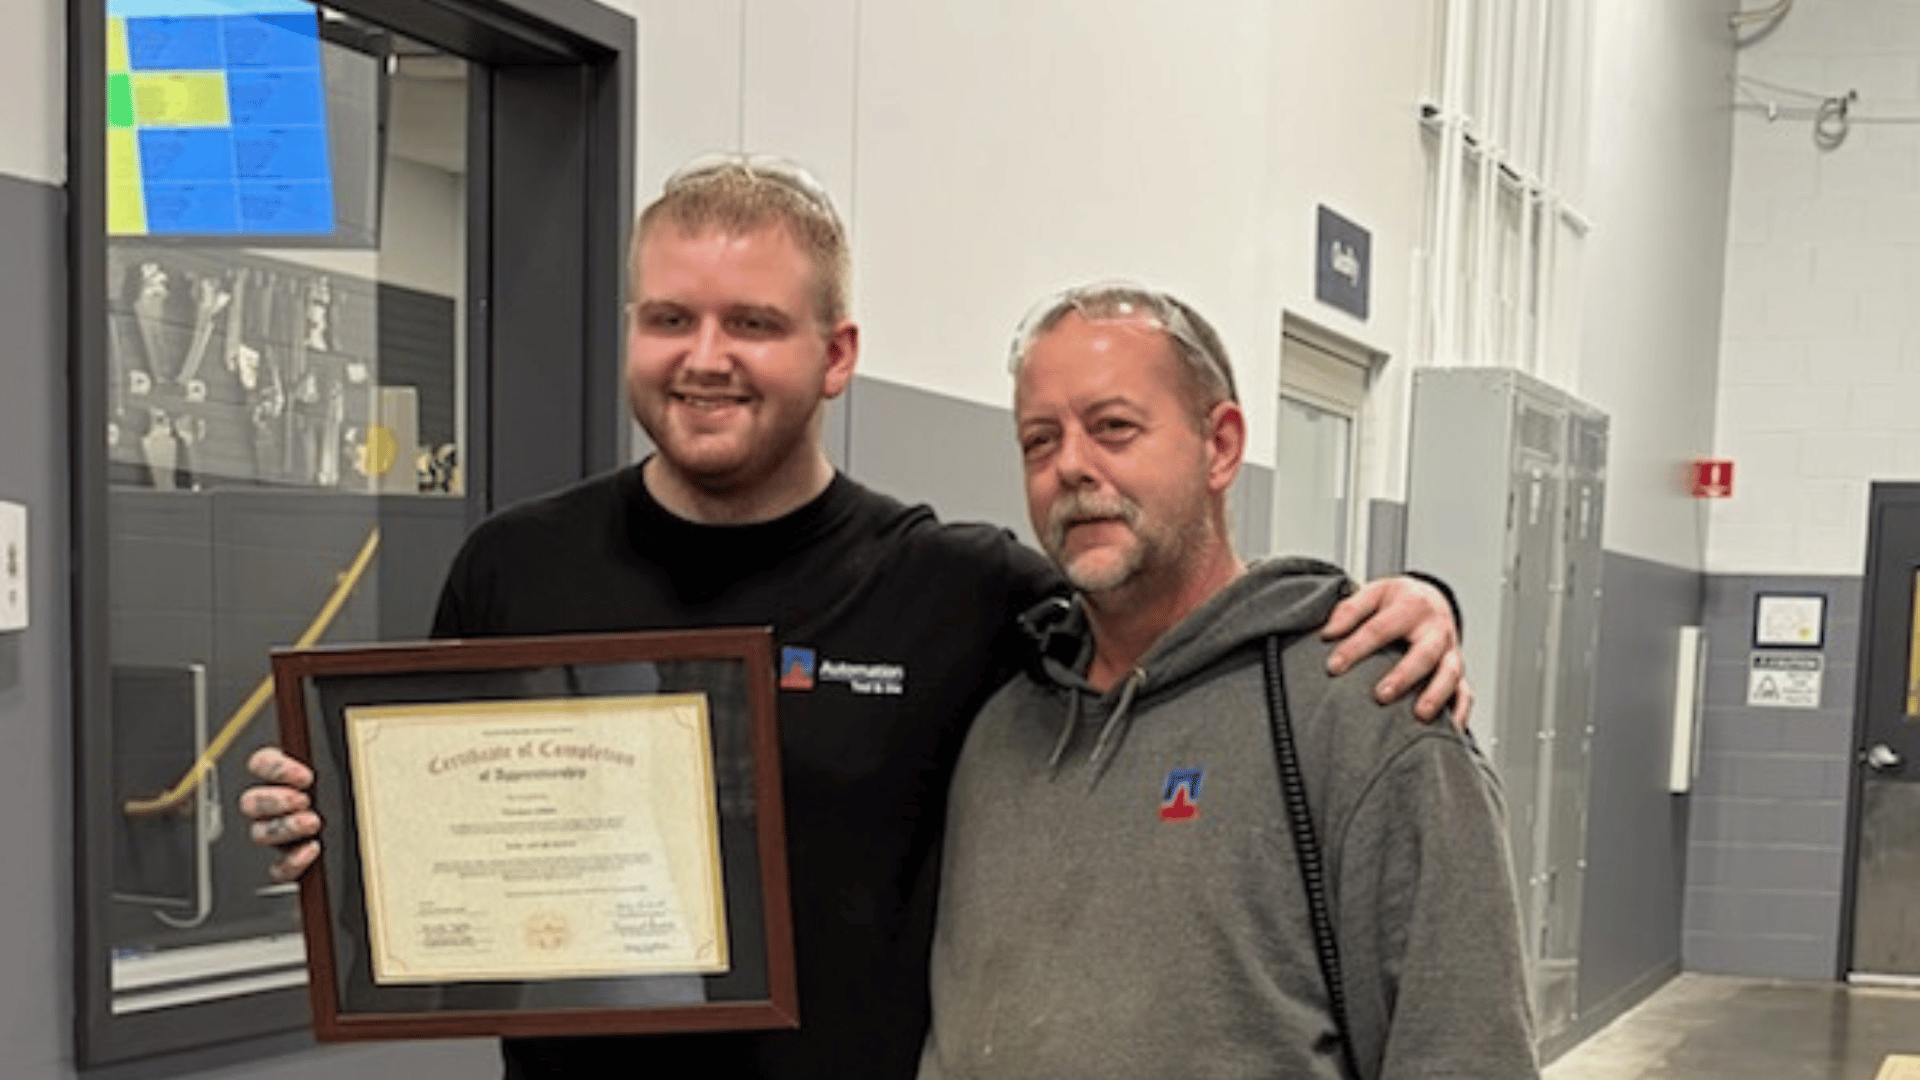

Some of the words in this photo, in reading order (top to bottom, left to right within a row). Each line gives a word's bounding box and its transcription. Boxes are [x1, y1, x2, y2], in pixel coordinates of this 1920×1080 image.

[819, 660, 904, 681] Automation
[428, 749, 510, 775] Certificate
[517, 740, 533, 759] of
[539, 739, 635, 767] Completion
